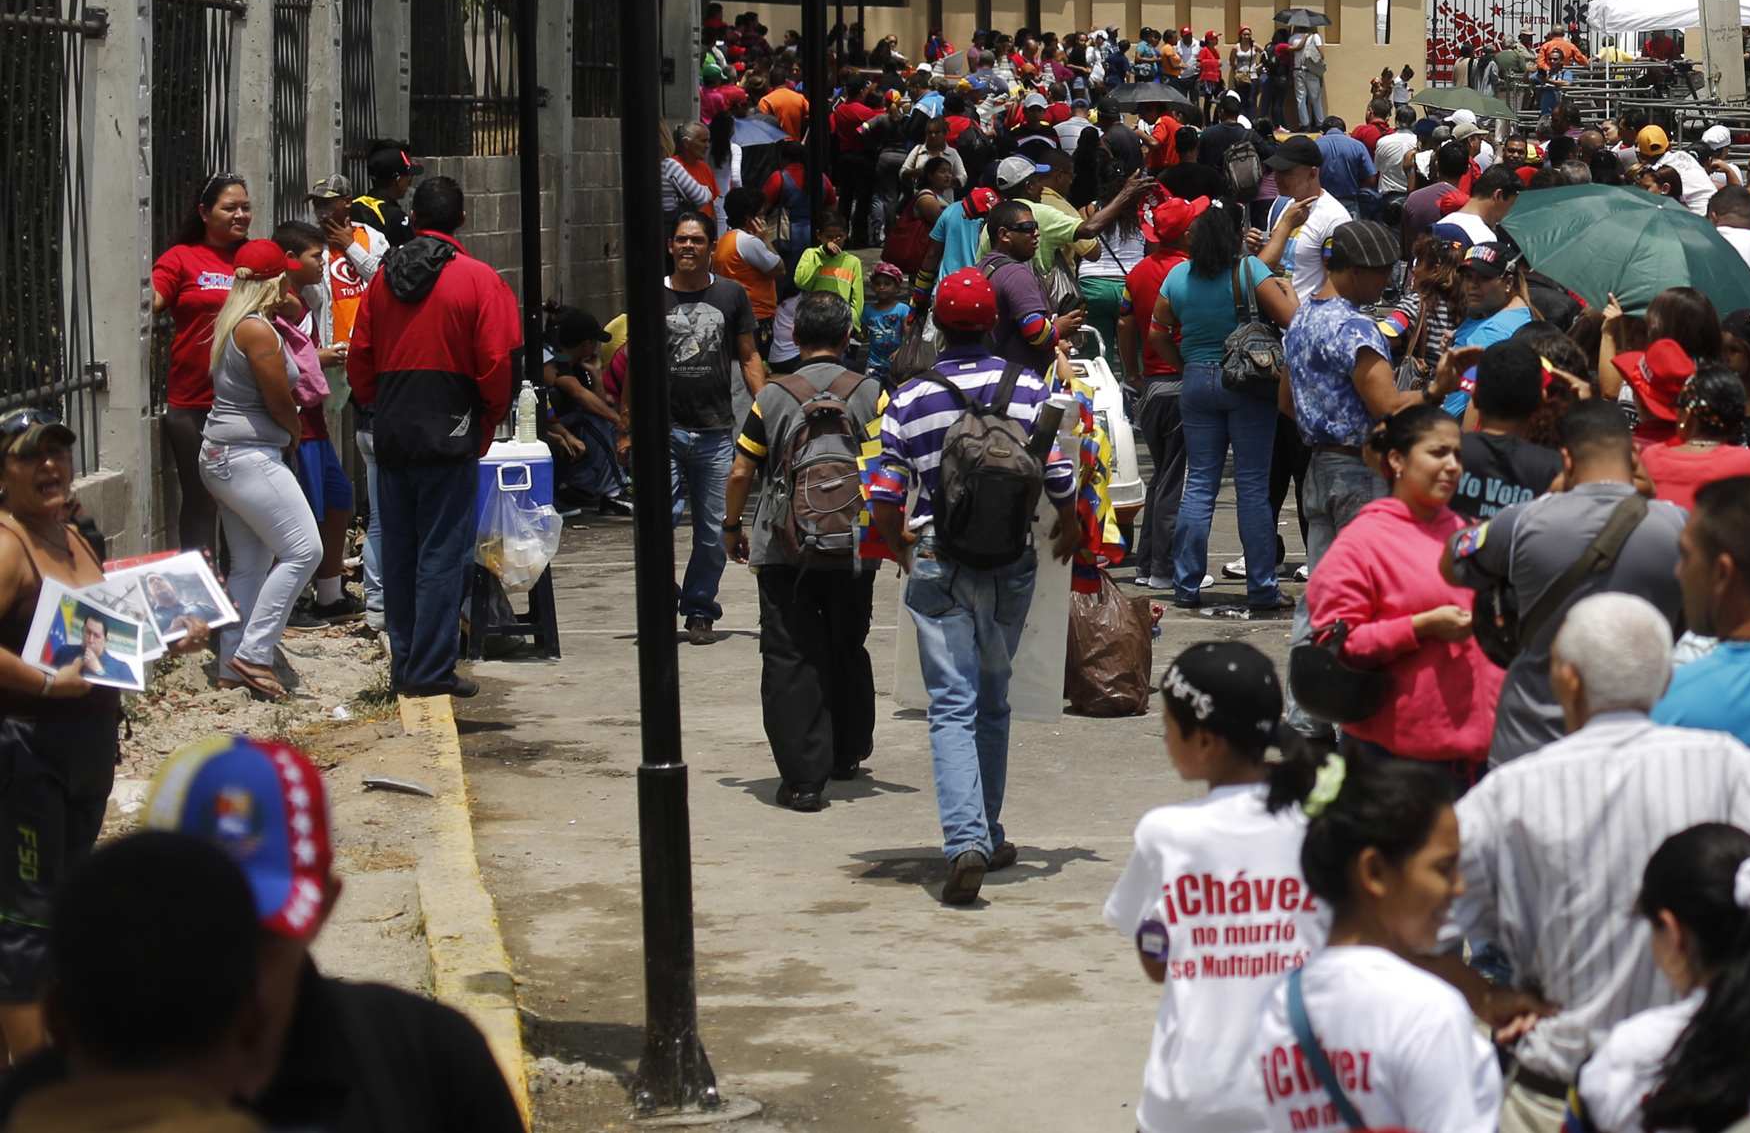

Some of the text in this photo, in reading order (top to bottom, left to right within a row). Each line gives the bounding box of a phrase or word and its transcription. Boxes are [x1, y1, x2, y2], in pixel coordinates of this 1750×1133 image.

[1192, 920, 1296, 947] no murió
[1170, 950, 1311, 980] se Multiplicó
